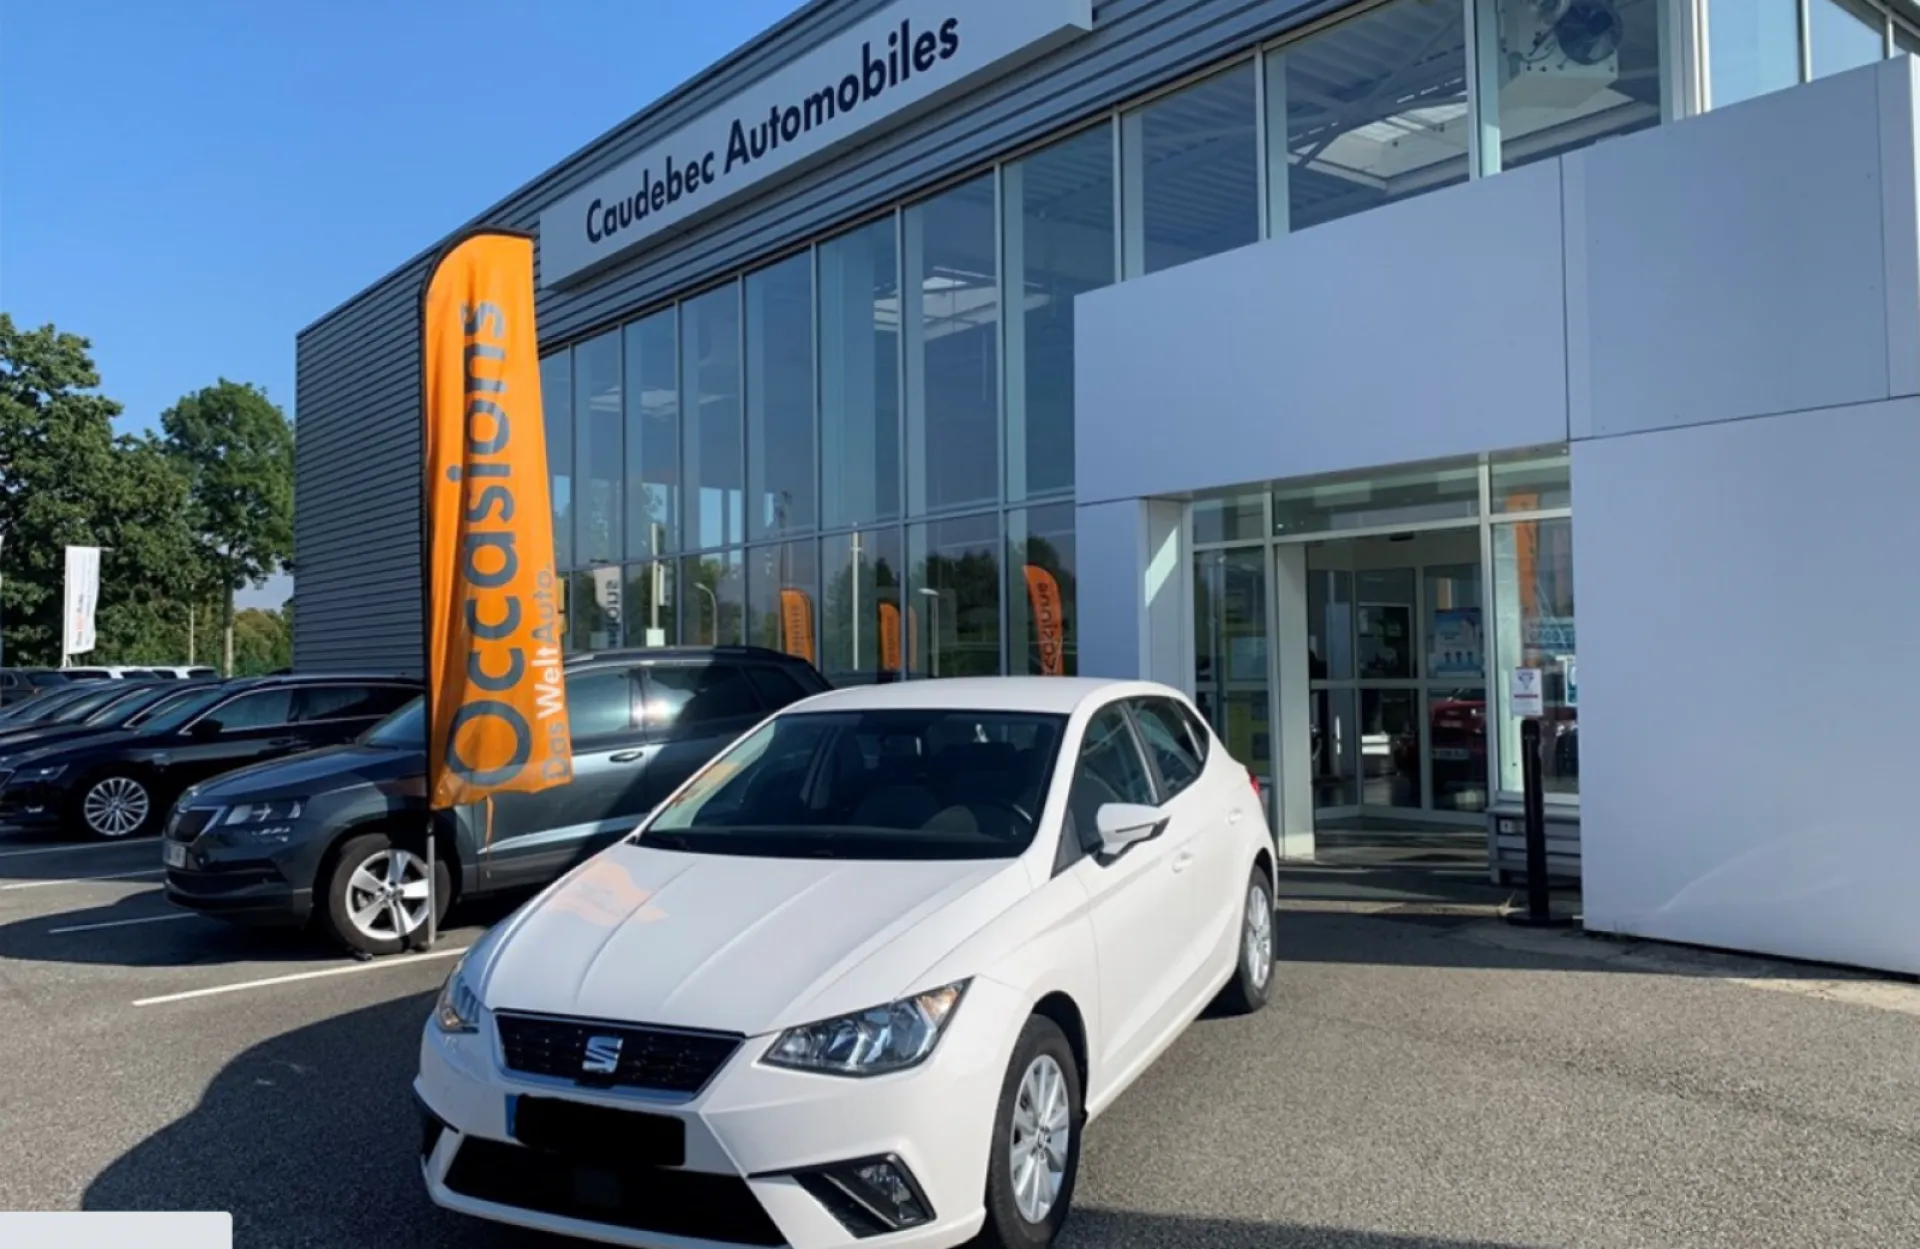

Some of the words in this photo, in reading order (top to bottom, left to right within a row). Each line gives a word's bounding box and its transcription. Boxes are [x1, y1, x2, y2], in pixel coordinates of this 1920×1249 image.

[586, 149, 714, 243] Caudebec
[723, 17, 959, 174] Automobiles
[446, 301, 532, 787] Occasions
[542, 720, 569, 778] Das
